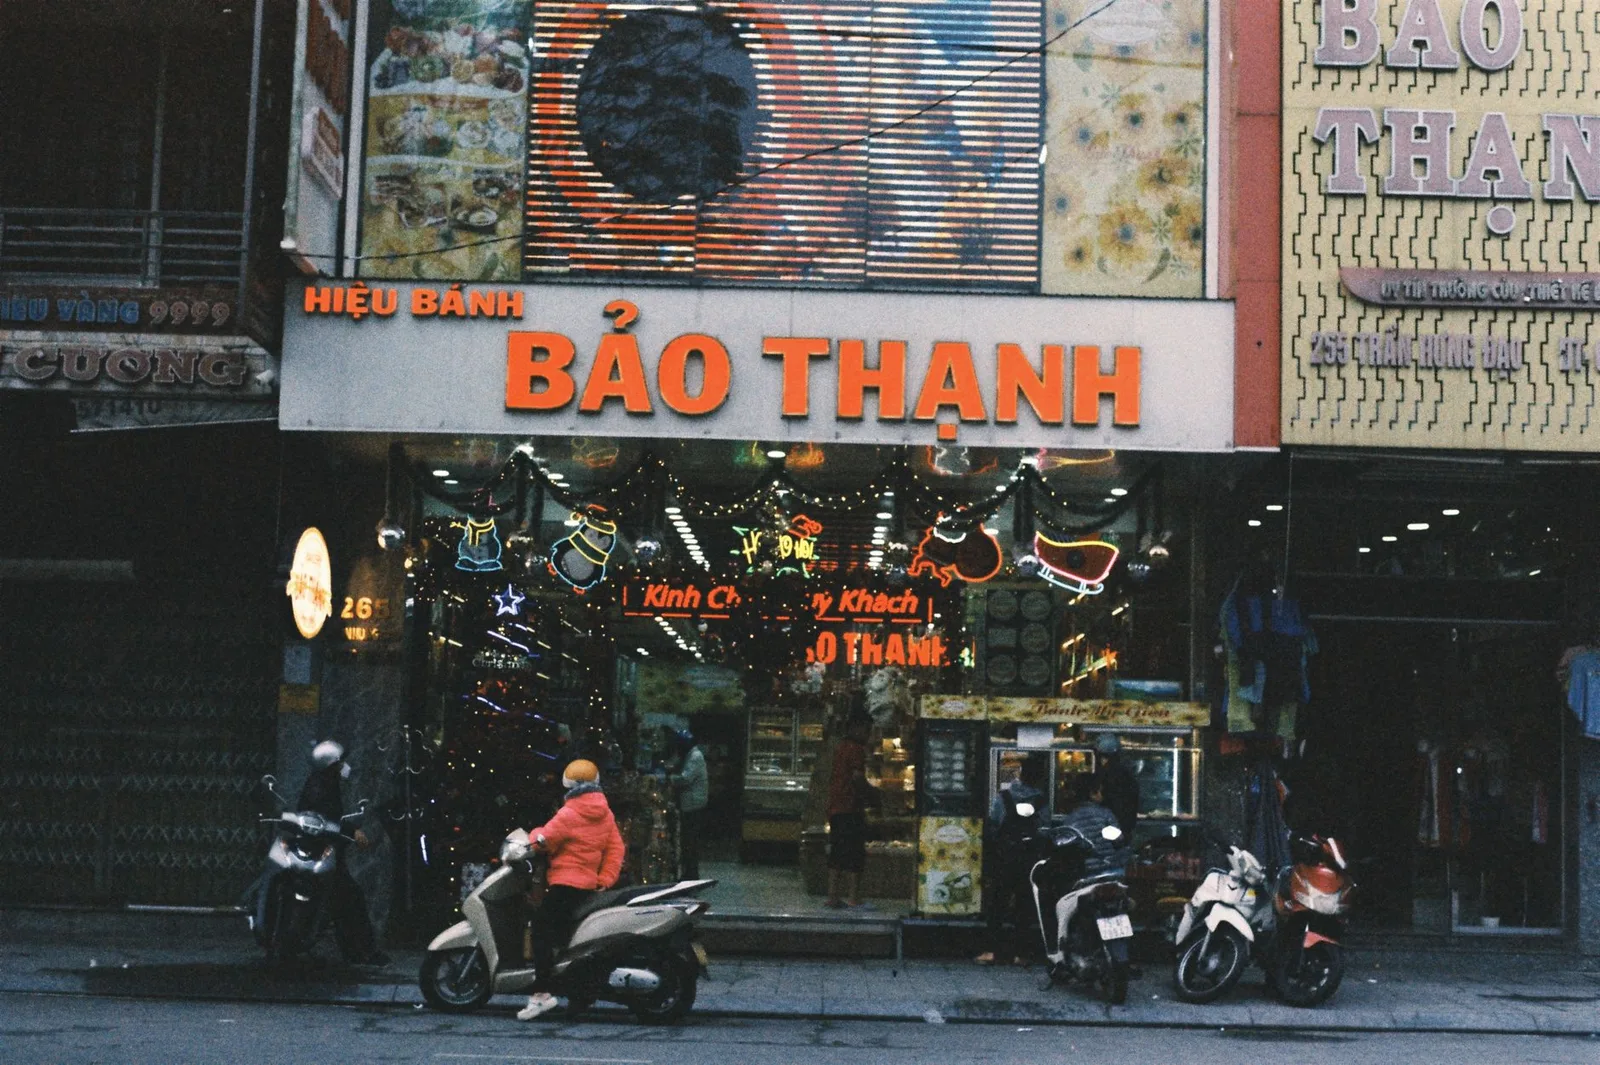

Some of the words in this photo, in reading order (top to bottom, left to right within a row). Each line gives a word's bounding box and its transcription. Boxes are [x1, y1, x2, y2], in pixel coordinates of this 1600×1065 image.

[149, 300, 230, 327] 9999
[304, 281, 398, 320] HIỆU
[410, 283, 524, 319] BÁNH
[1310, 331, 1349, 367] 255
[504, 299, 732, 416] BẢO
[761, 336, 1142, 441] THẠNH
